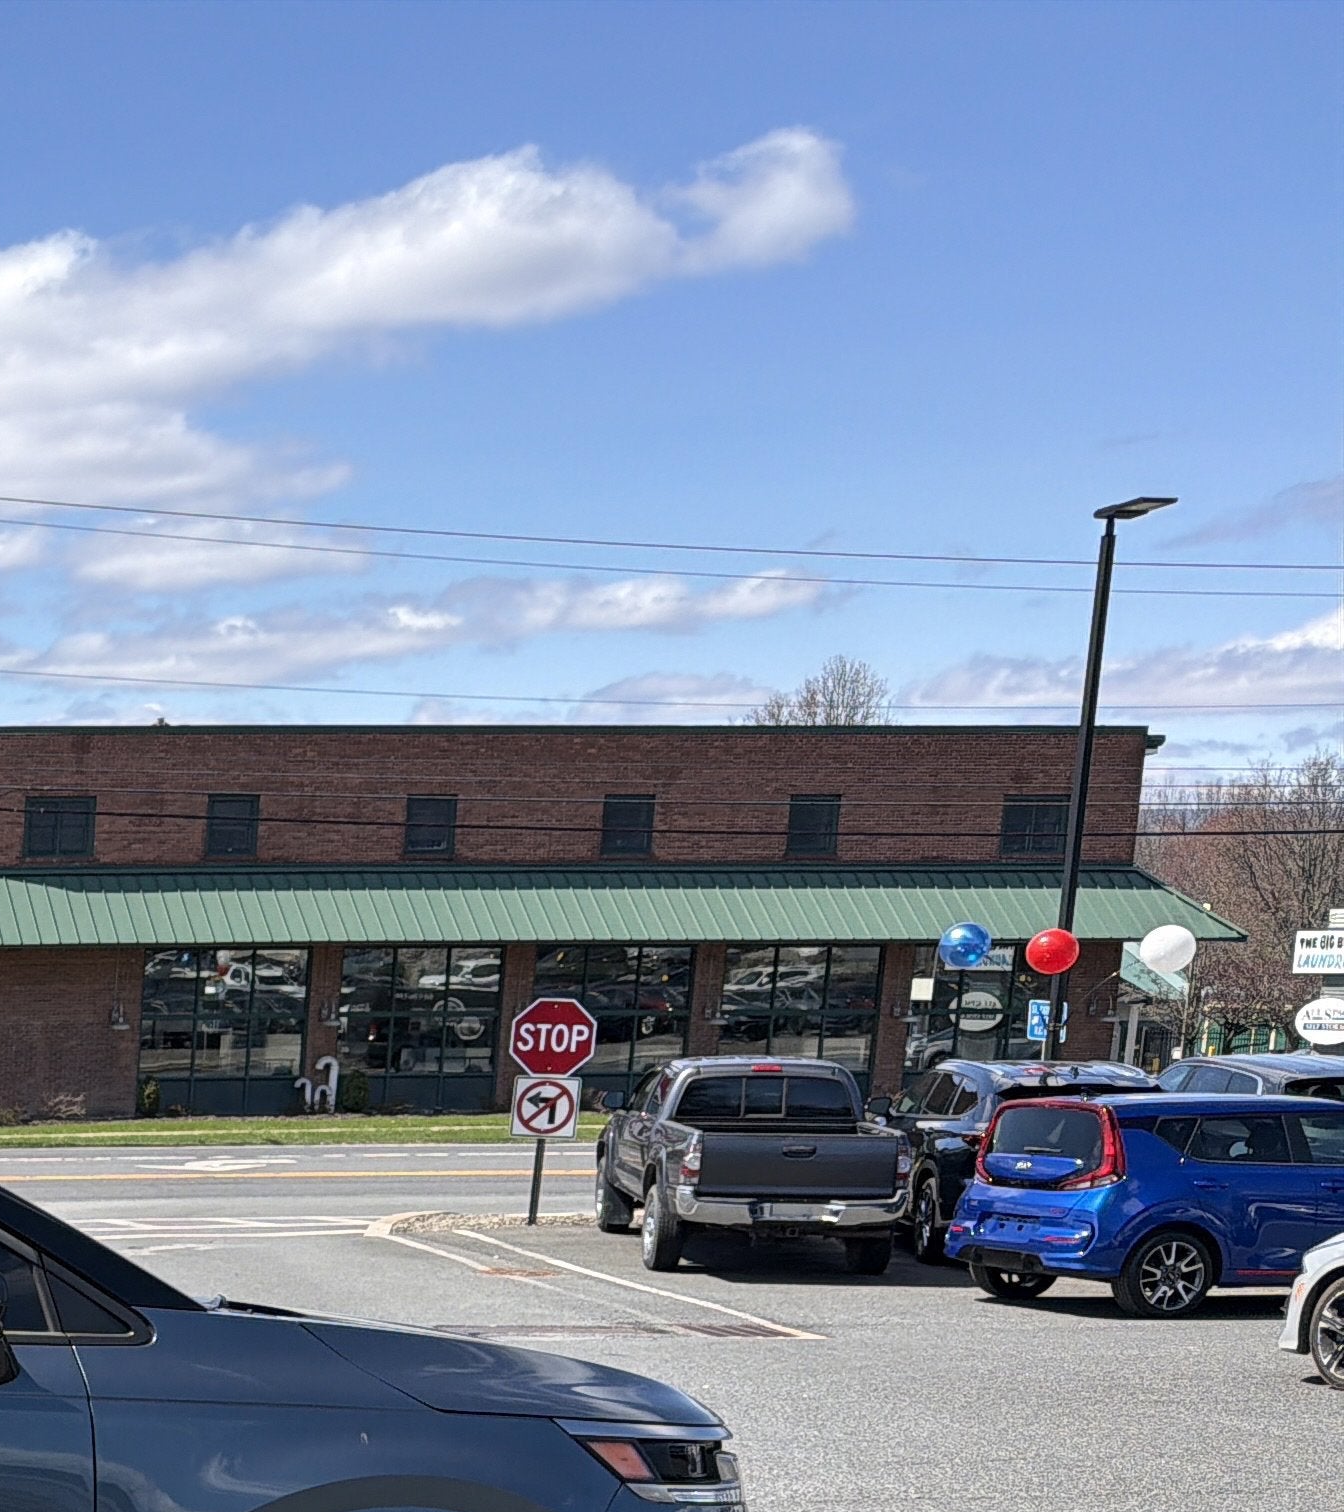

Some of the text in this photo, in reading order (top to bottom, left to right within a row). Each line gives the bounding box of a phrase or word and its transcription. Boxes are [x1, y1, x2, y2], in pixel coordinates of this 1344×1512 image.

[1300, 938, 1318, 949] THE
[1320, 935, 1334, 950] BIG
[1297, 954, 1344, 969] LAUNDR
[517, 1023, 589, 1052] STOP
